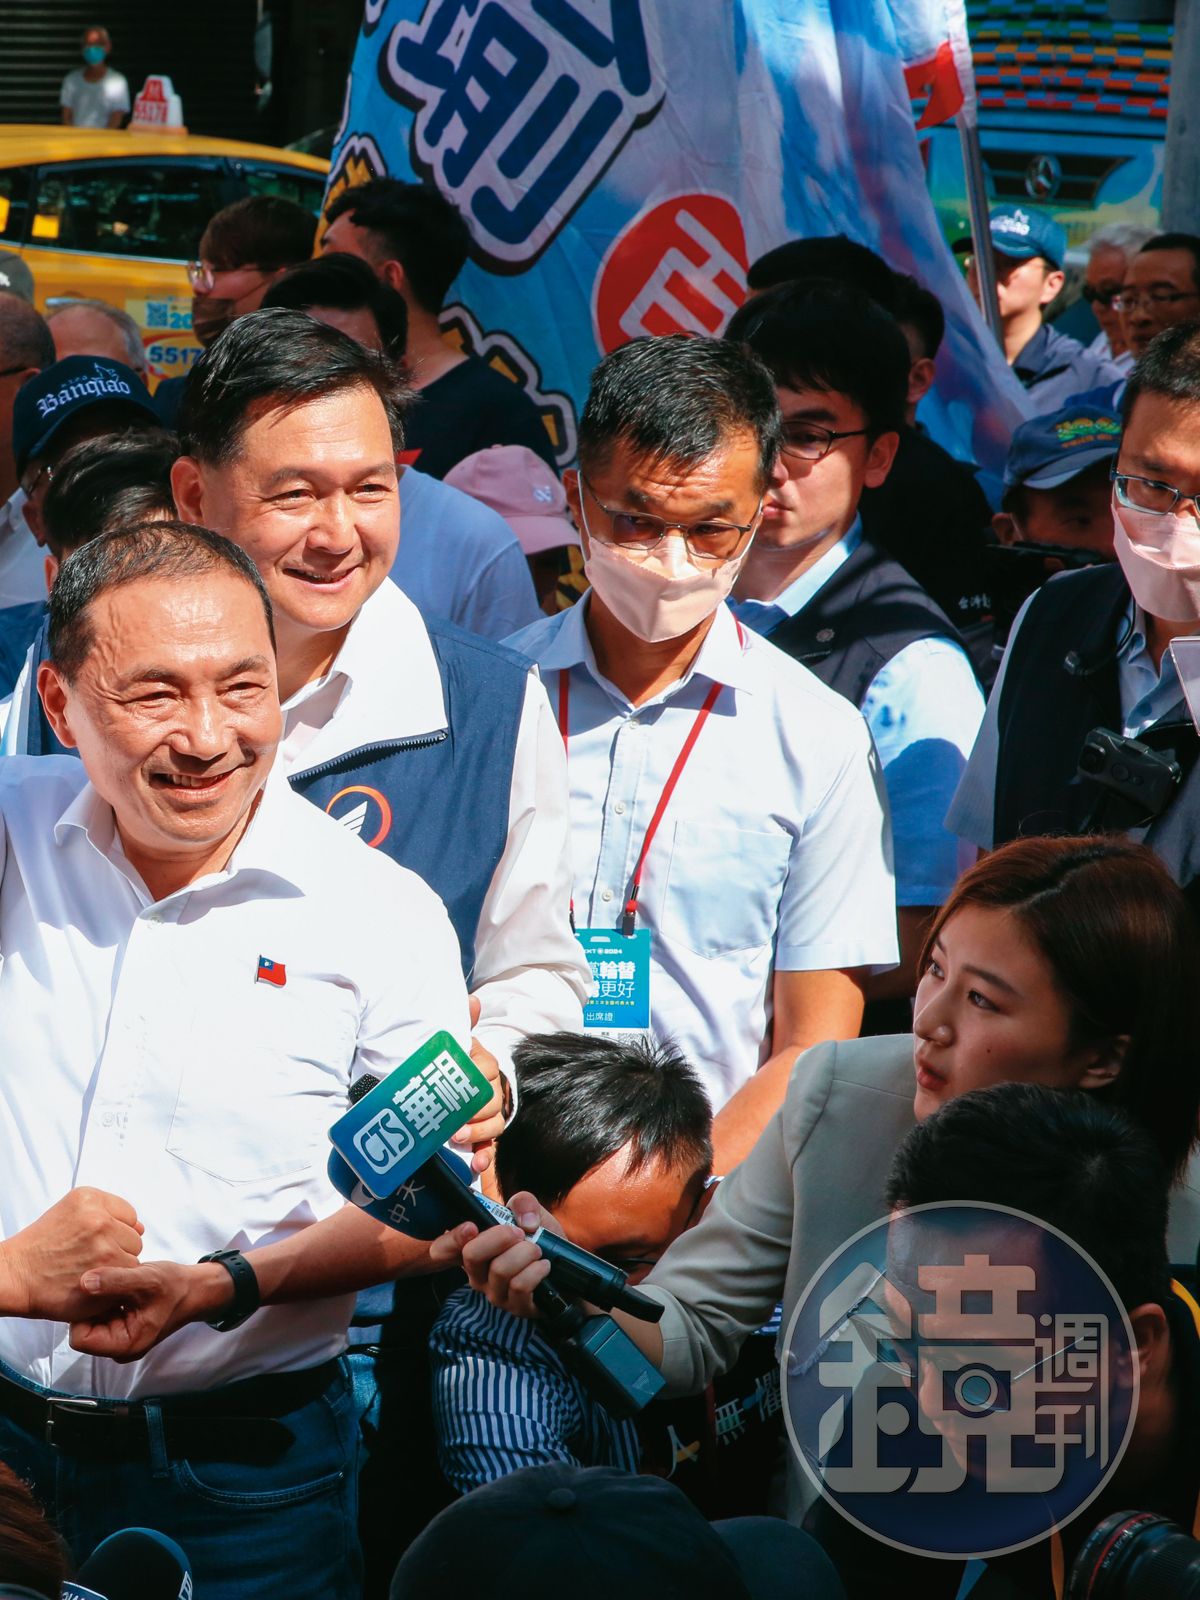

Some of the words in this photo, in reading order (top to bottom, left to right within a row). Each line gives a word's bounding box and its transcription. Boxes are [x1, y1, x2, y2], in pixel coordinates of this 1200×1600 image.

[36, 380, 131, 418] Banqiao
[586, 1011, 614, 1022] 出席證
[358, 1110, 409, 1171] CTS
[392, 1050, 480, 1139] 華視
